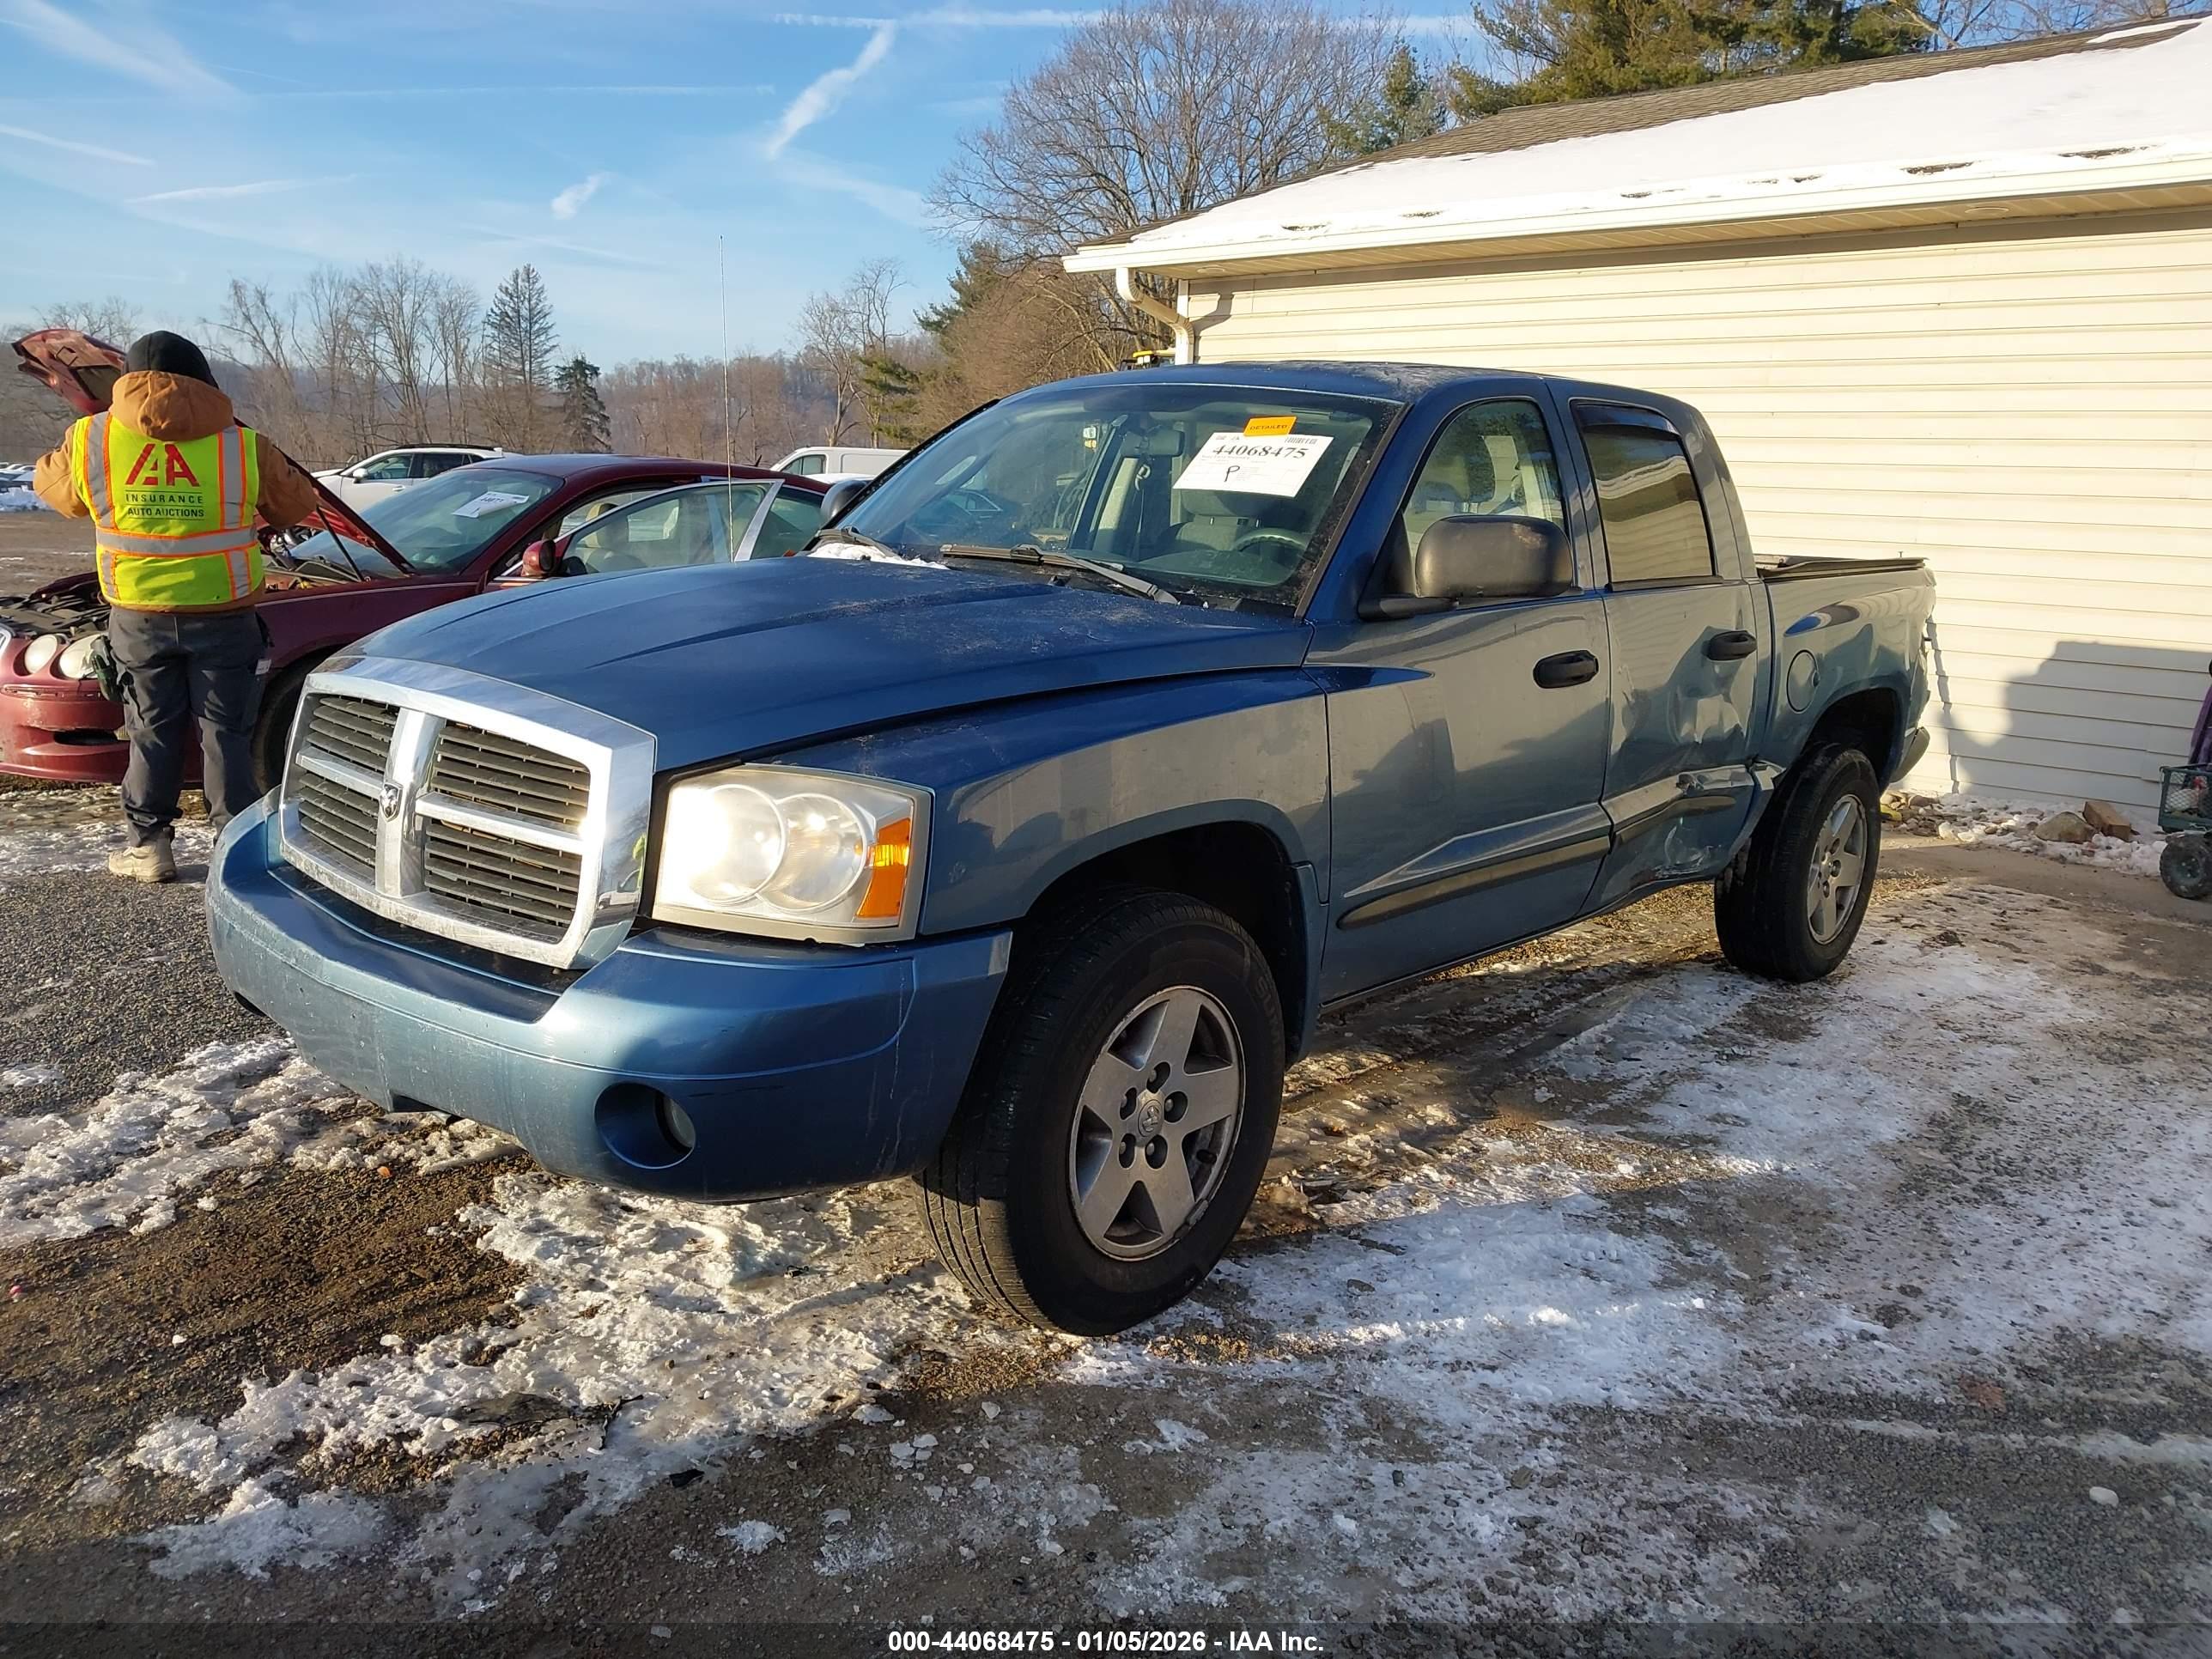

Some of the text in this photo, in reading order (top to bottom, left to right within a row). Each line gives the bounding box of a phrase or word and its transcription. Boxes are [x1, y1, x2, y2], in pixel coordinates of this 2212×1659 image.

[1212, 444, 1310, 459] 44068475
[125, 494, 204, 504] INSURANCE
[127, 507, 205, 517] AUTO AUCTIONS
